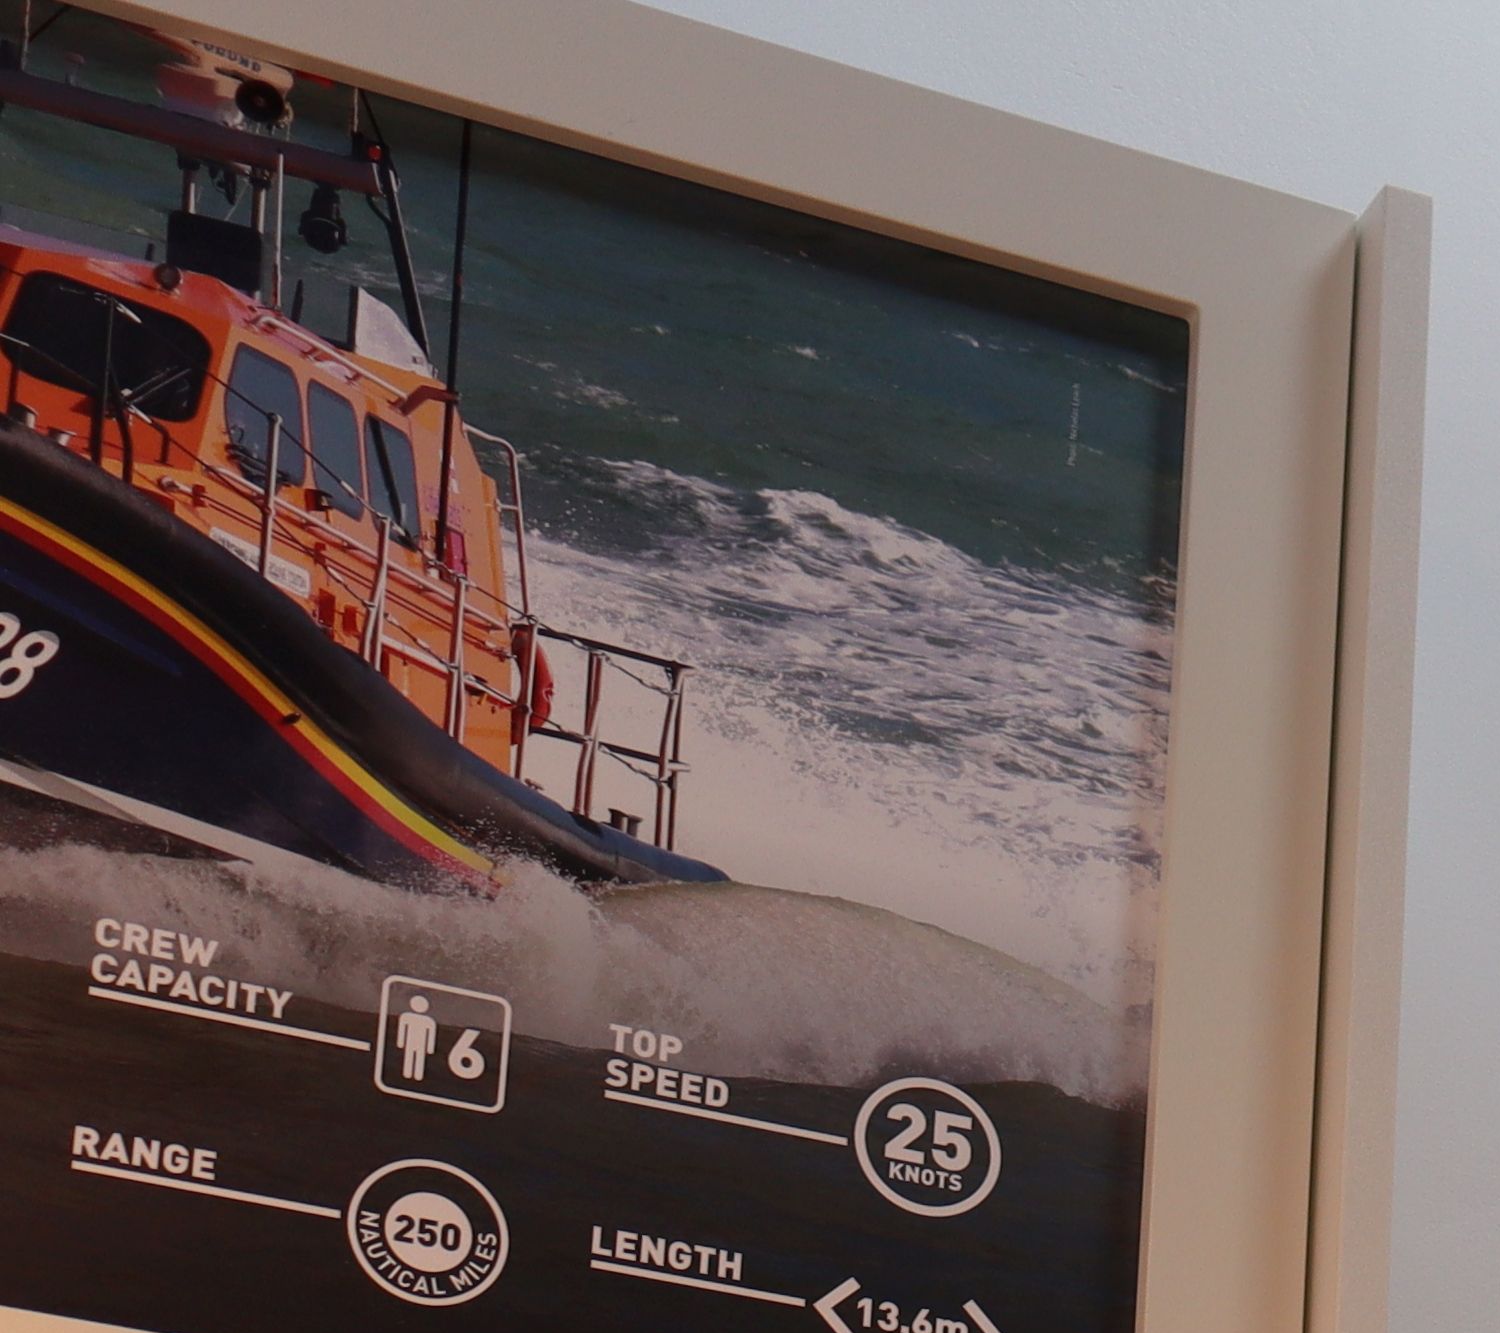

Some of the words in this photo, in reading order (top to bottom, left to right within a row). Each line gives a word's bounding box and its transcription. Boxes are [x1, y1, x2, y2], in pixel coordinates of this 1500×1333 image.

[94, 918, 219, 968] CREW
[90, 953, 293, 1020] CAPACITY
[448, 1029, 486, 1080] 6
[609, 1023, 683, 1062] TOP
[604, 1058, 729, 1108] SPEED
[72, 1125, 218, 1181] RANGE
[884, 1103, 973, 1173] 25
[889, 1161, 963, 1192] KNOTS
[360, 1210, 447, 1296] NAUTICAL
[452, 1231, 497, 1292] MILES
[393, 1214, 461, 1252] 250
[591, 1225, 743, 1281] LENGTH
